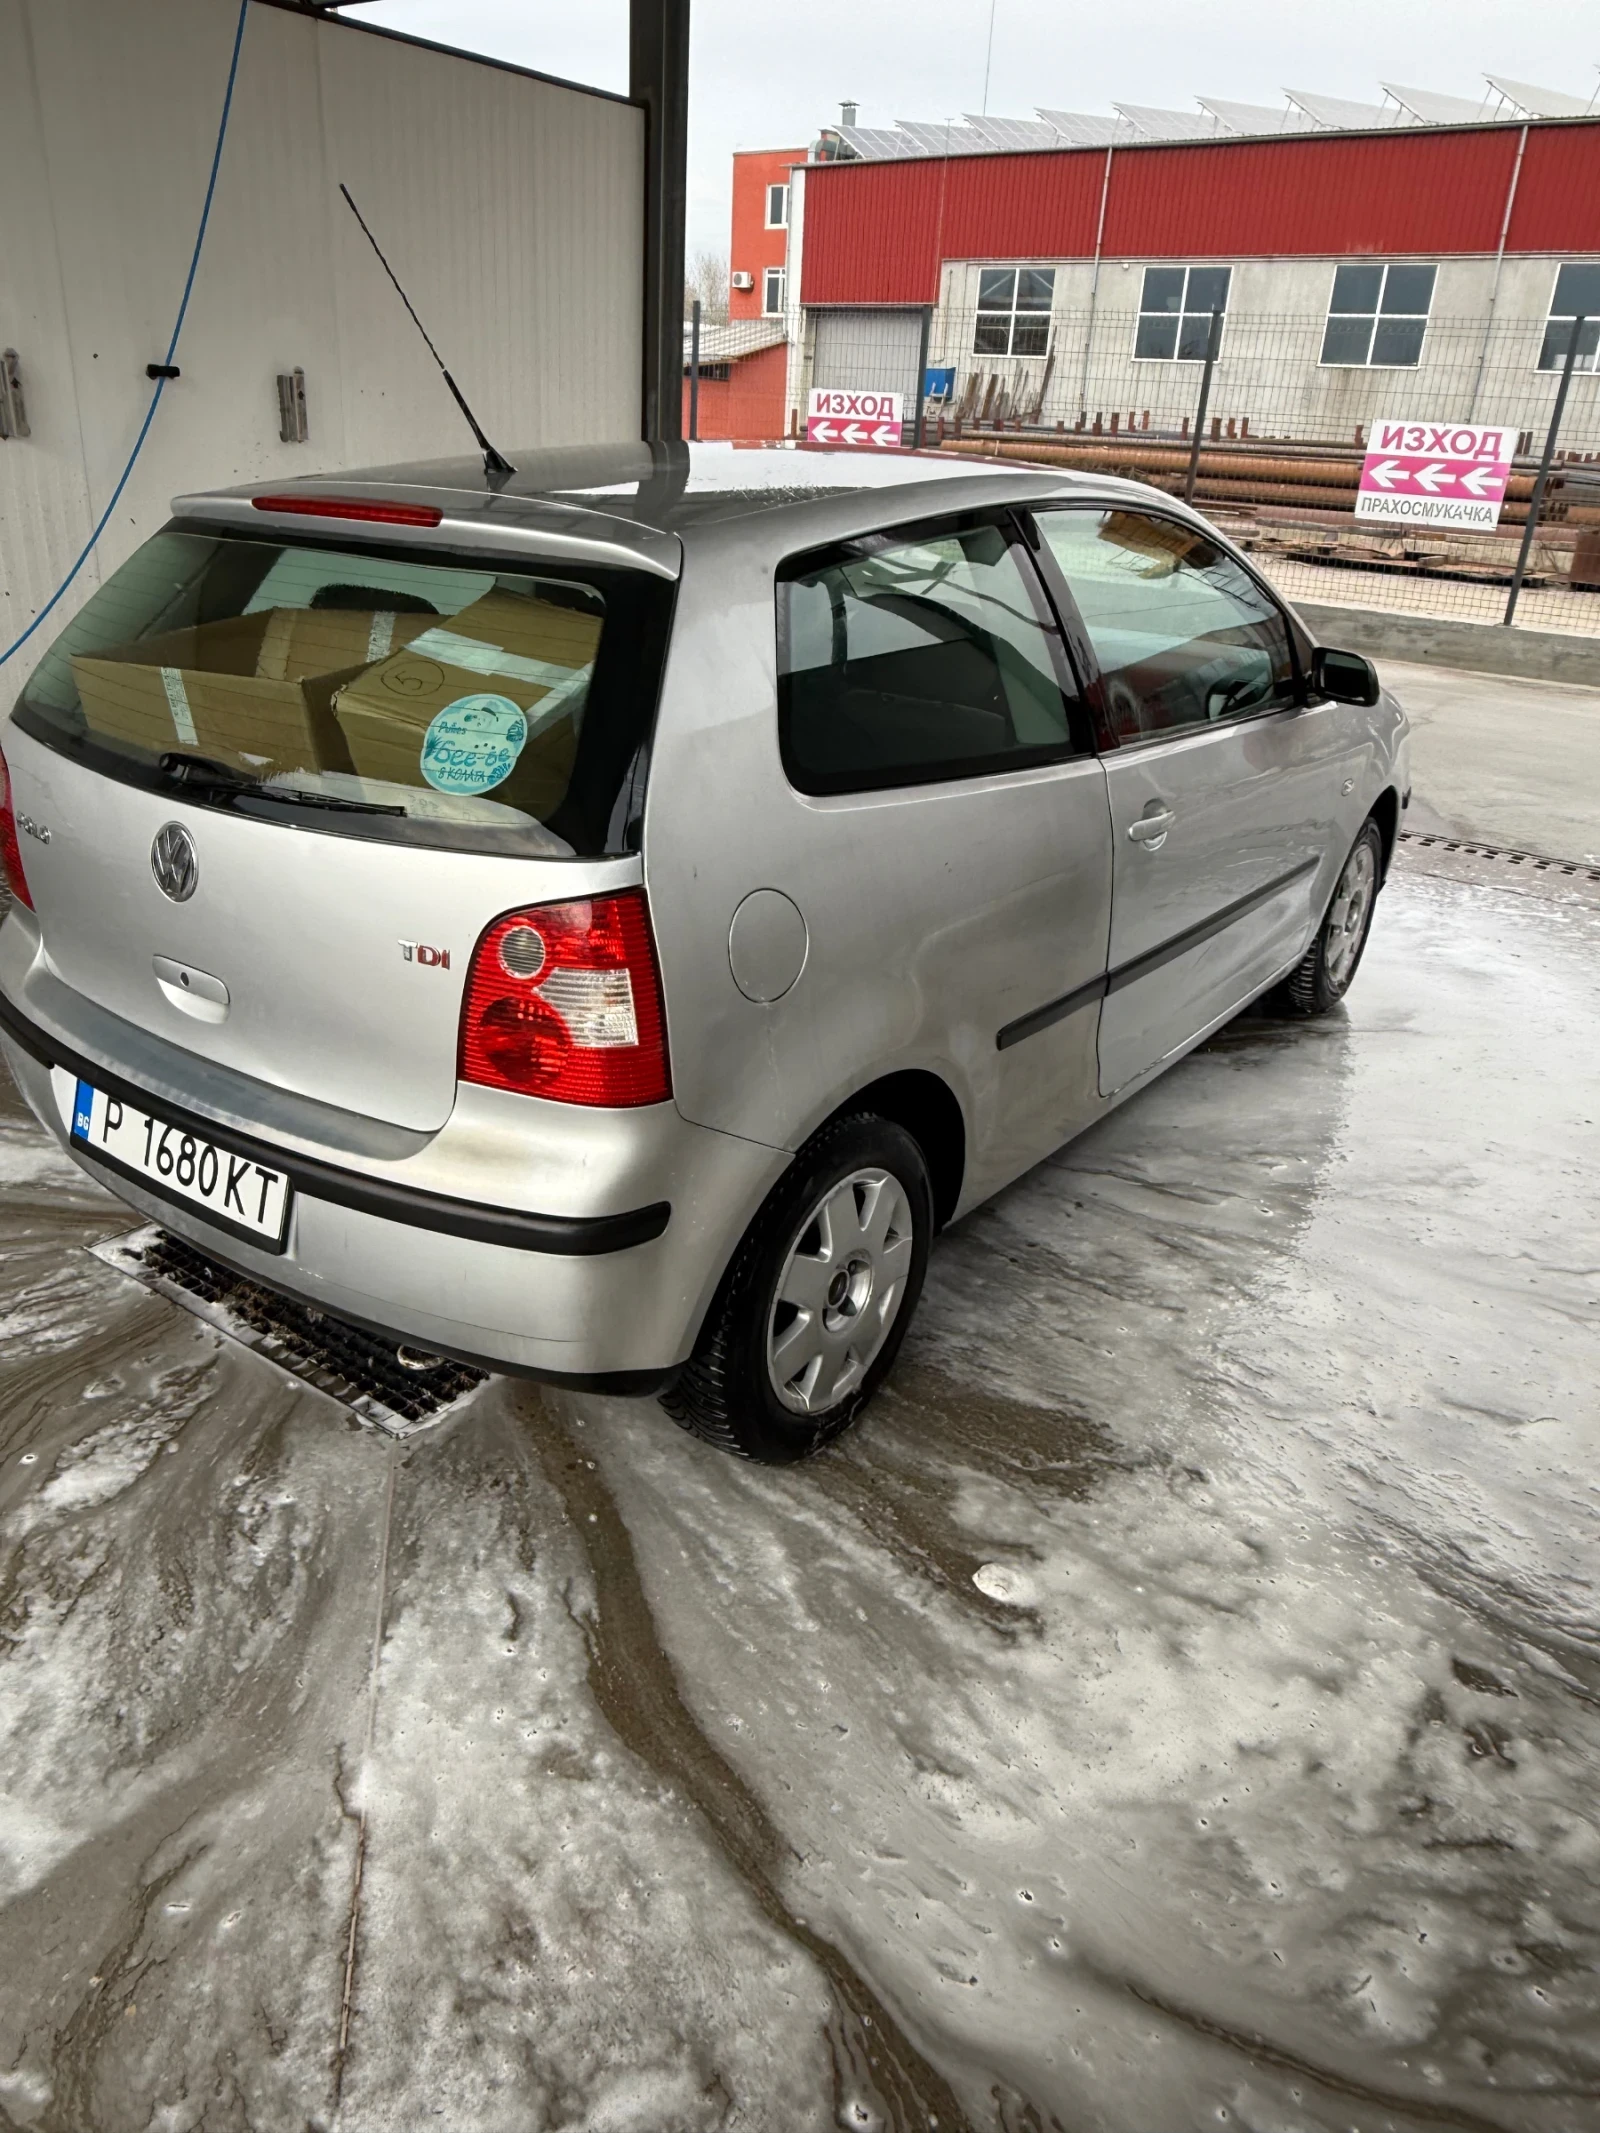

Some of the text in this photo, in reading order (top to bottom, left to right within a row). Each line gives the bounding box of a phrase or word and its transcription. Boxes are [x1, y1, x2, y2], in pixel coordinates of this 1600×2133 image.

[816, 393, 894, 421] ИЗХОД
[1380, 425, 1503, 461] ИЗХОД
[1361, 497, 1493, 523] ПРАХОСМУКАЧКА
[395, 671, 423, 691] 5
[398, 939, 450, 970] TDI
[76, 1112, 90, 1131] BG
[144, 1118, 219, 1197] 1680
